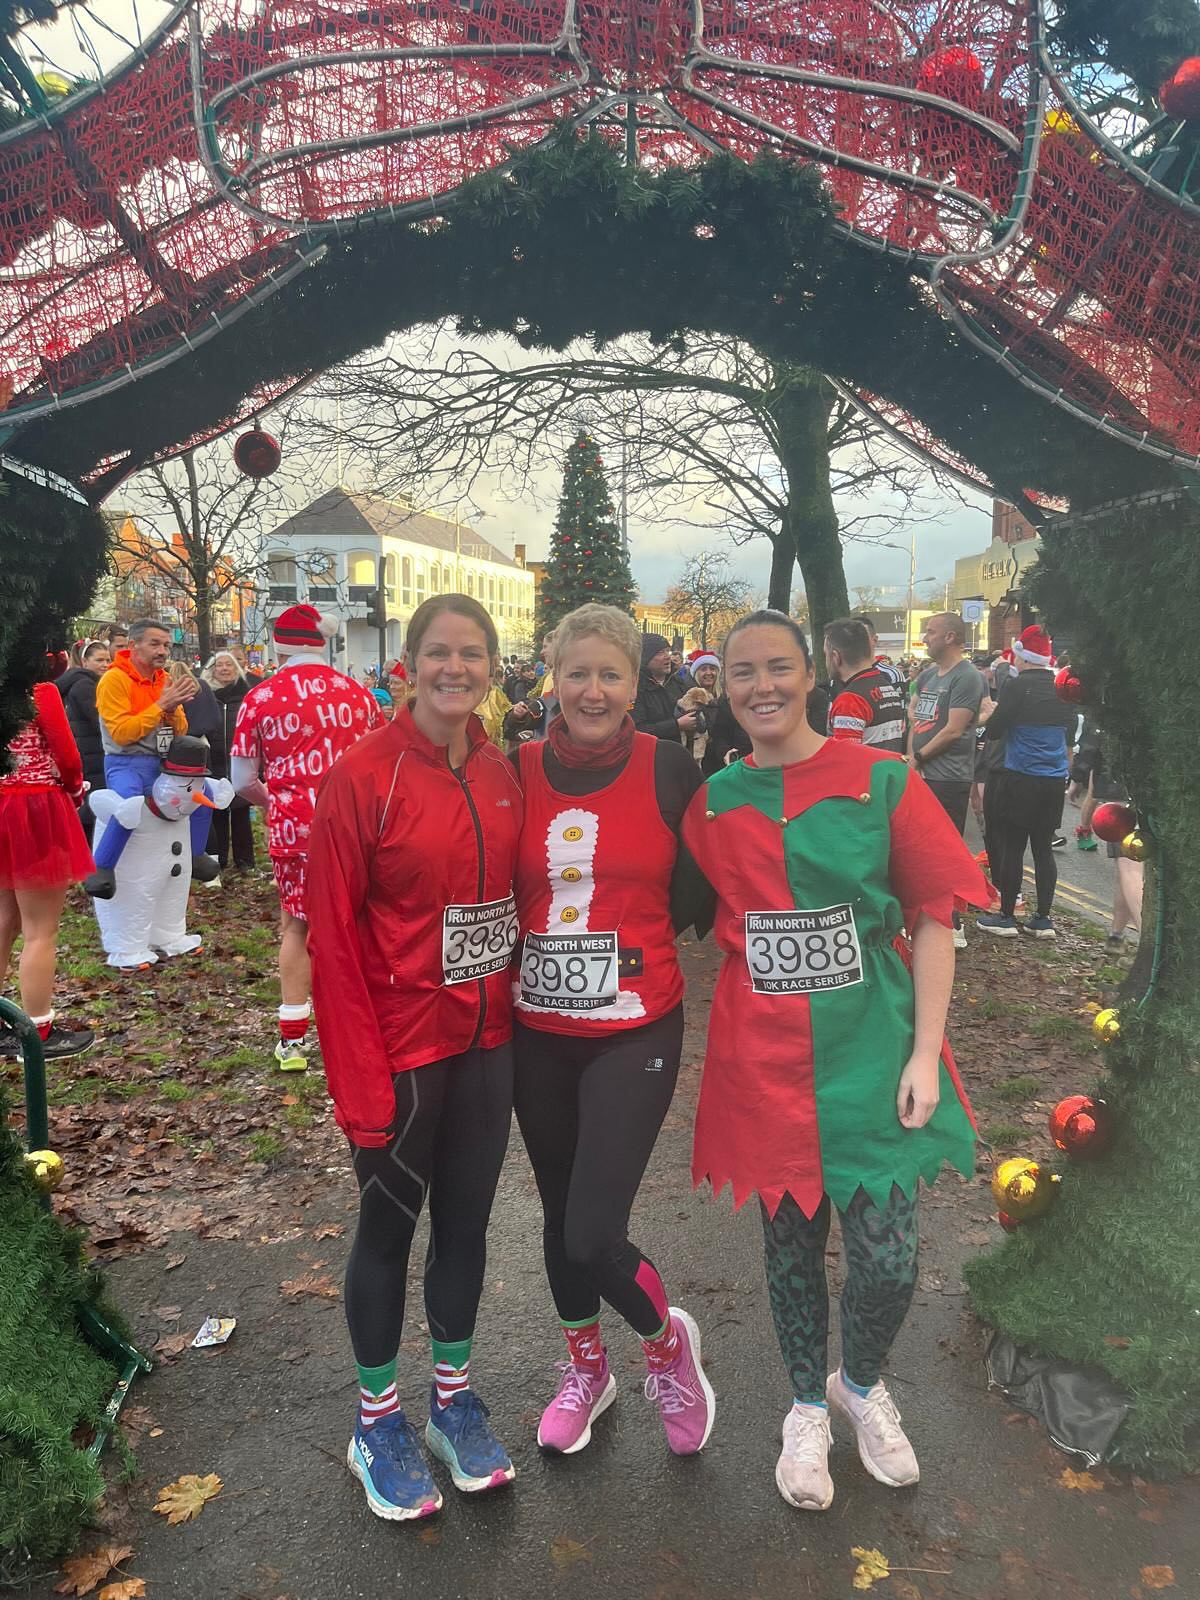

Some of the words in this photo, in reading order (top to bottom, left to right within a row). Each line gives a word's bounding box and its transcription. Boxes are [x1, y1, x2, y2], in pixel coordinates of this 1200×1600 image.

[316, 702, 353, 729] HO
[449, 909, 475, 923] RUN
[476, 905, 505, 921] NORTH
[750, 916, 774, 930] RUN
[775, 918, 816, 930] NORTH
[819, 910, 848, 927] WEST
[446, 915, 519, 964] 3986
[540, 940, 578, 951] NORTH
[580, 939, 612, 950] WEST
[751, 929, 857, 974] 3988
[450, 969, 467, 979] 10K
[468, 962, 490, 976] RACE
[523, 952, 612, 993] 3987
[763, 980, 780, 990] 10K
[781, 979, 812, 990] RACE
[815, 973, 850, 987] SERIES
[529, 994, 542, 1004] 10K
[544, 997, 570, 1007] RACE
[358, 1436, 375, 1468] HOKA
